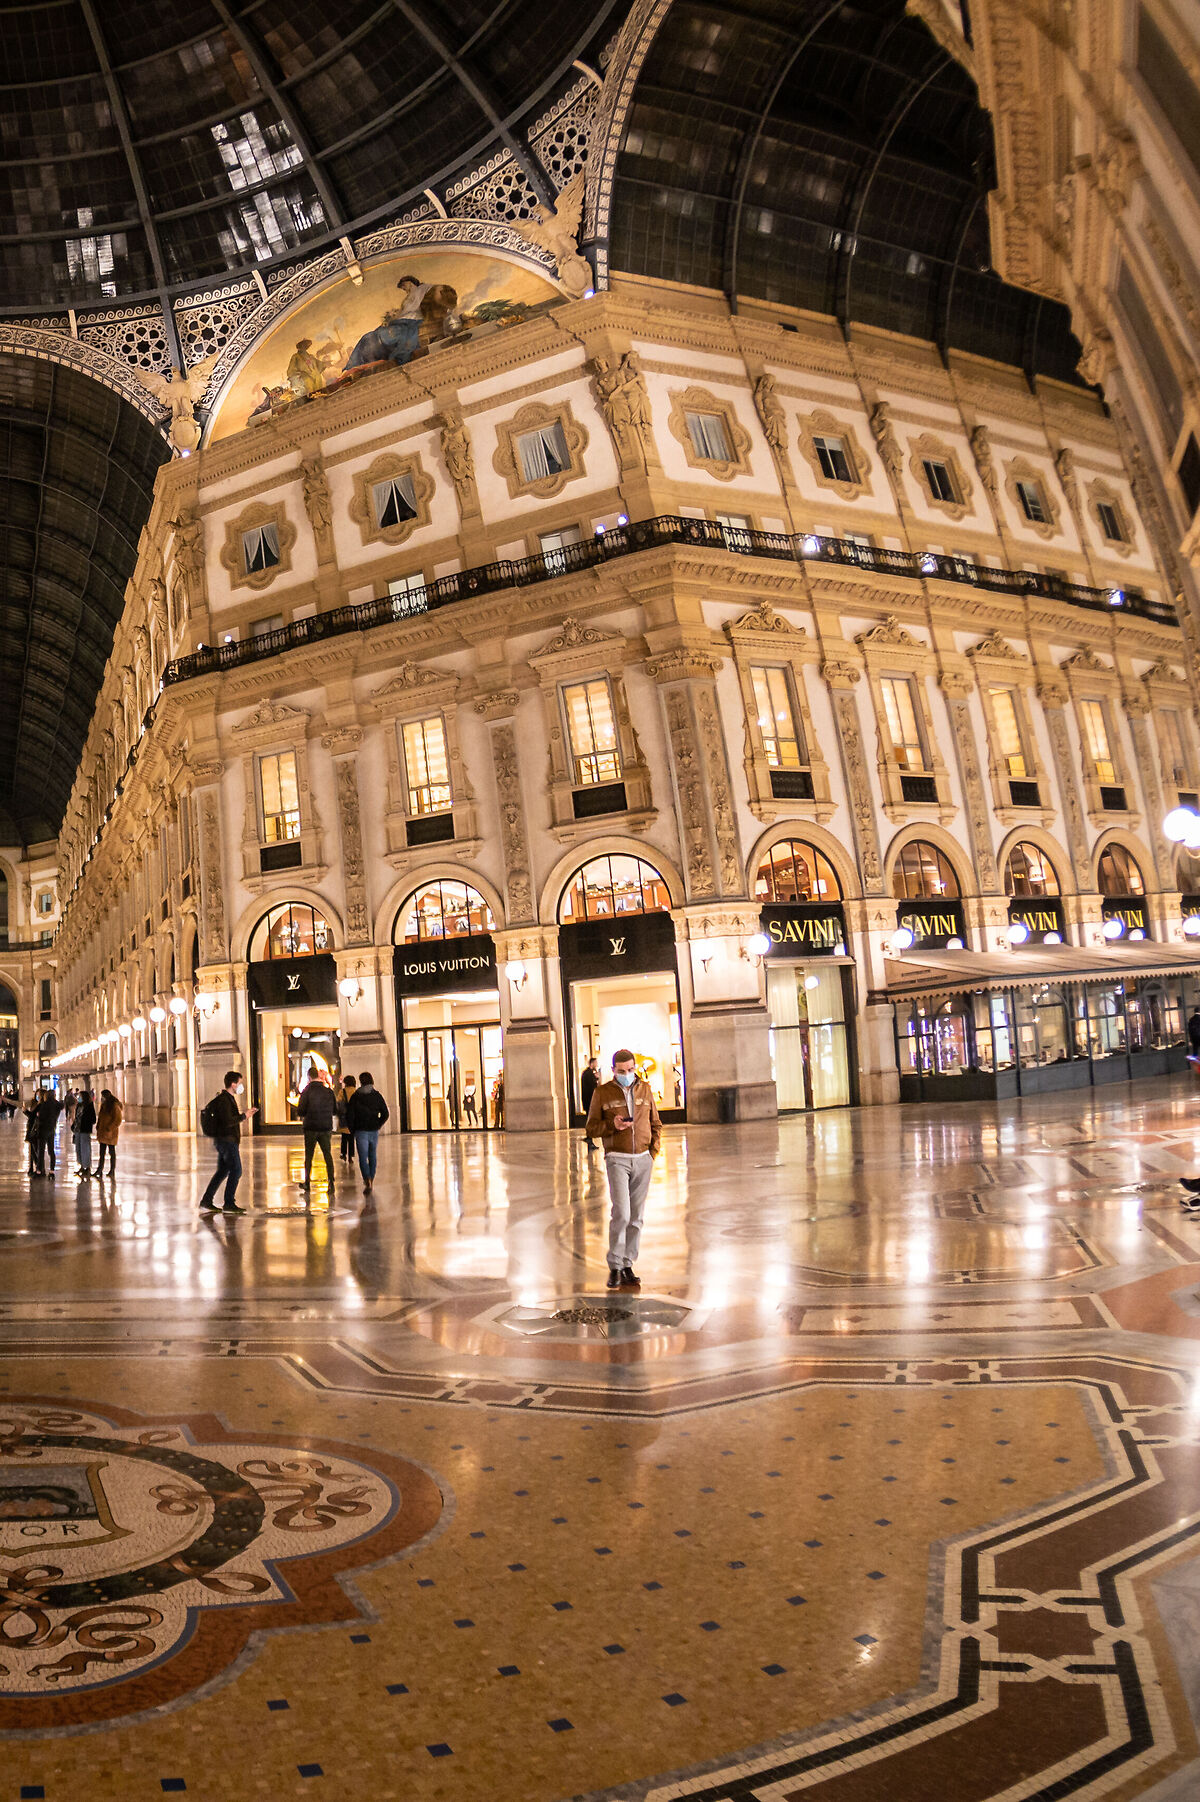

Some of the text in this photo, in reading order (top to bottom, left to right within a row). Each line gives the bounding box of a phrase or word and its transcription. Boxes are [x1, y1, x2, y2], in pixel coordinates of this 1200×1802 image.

[769, 918, 836, 943] SAVINI
[901, 914, 957, 936] SAVINI
[403, 955, 490, 976] LOUIS VUITTON
